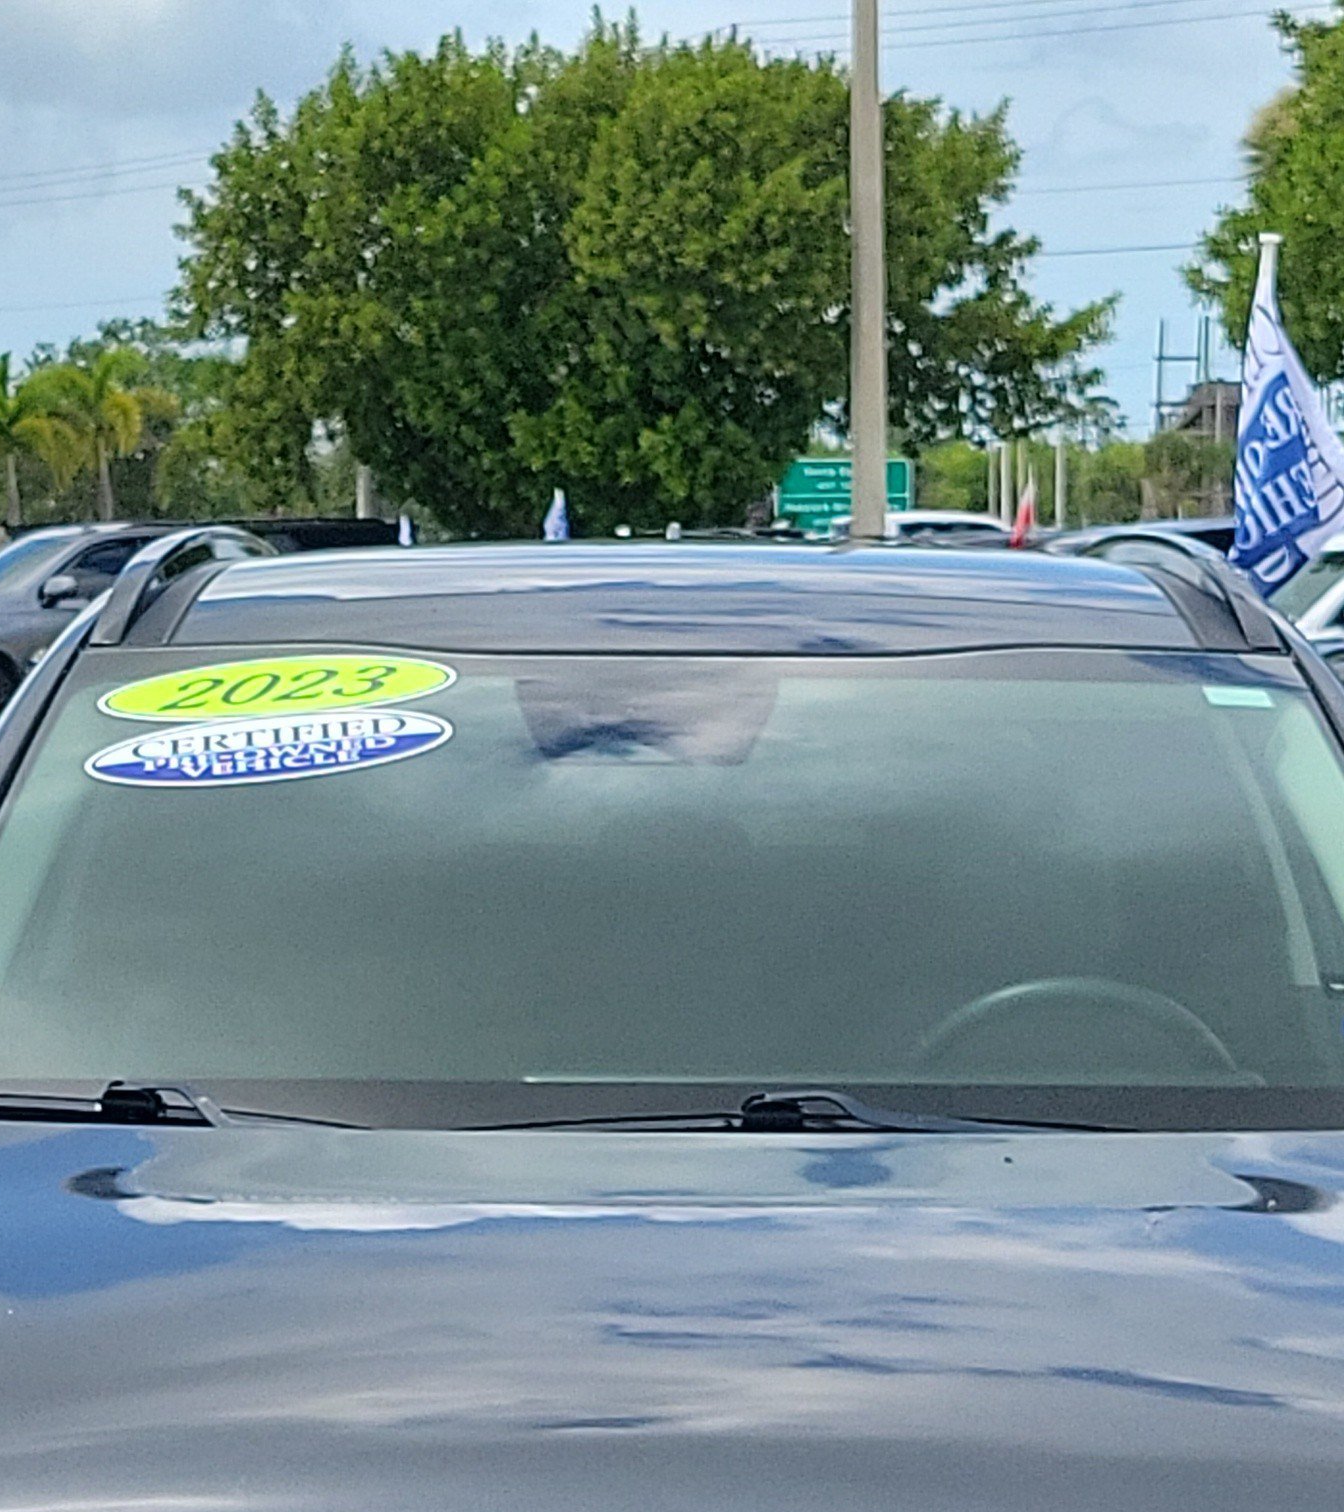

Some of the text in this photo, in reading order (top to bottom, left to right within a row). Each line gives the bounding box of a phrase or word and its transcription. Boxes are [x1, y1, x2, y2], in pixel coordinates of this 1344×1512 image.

[156, 665, 398, 713] 2023
[131, 713, 407, 760] CERTIFIED
[183, 749, 363, 779] VEHICLE
